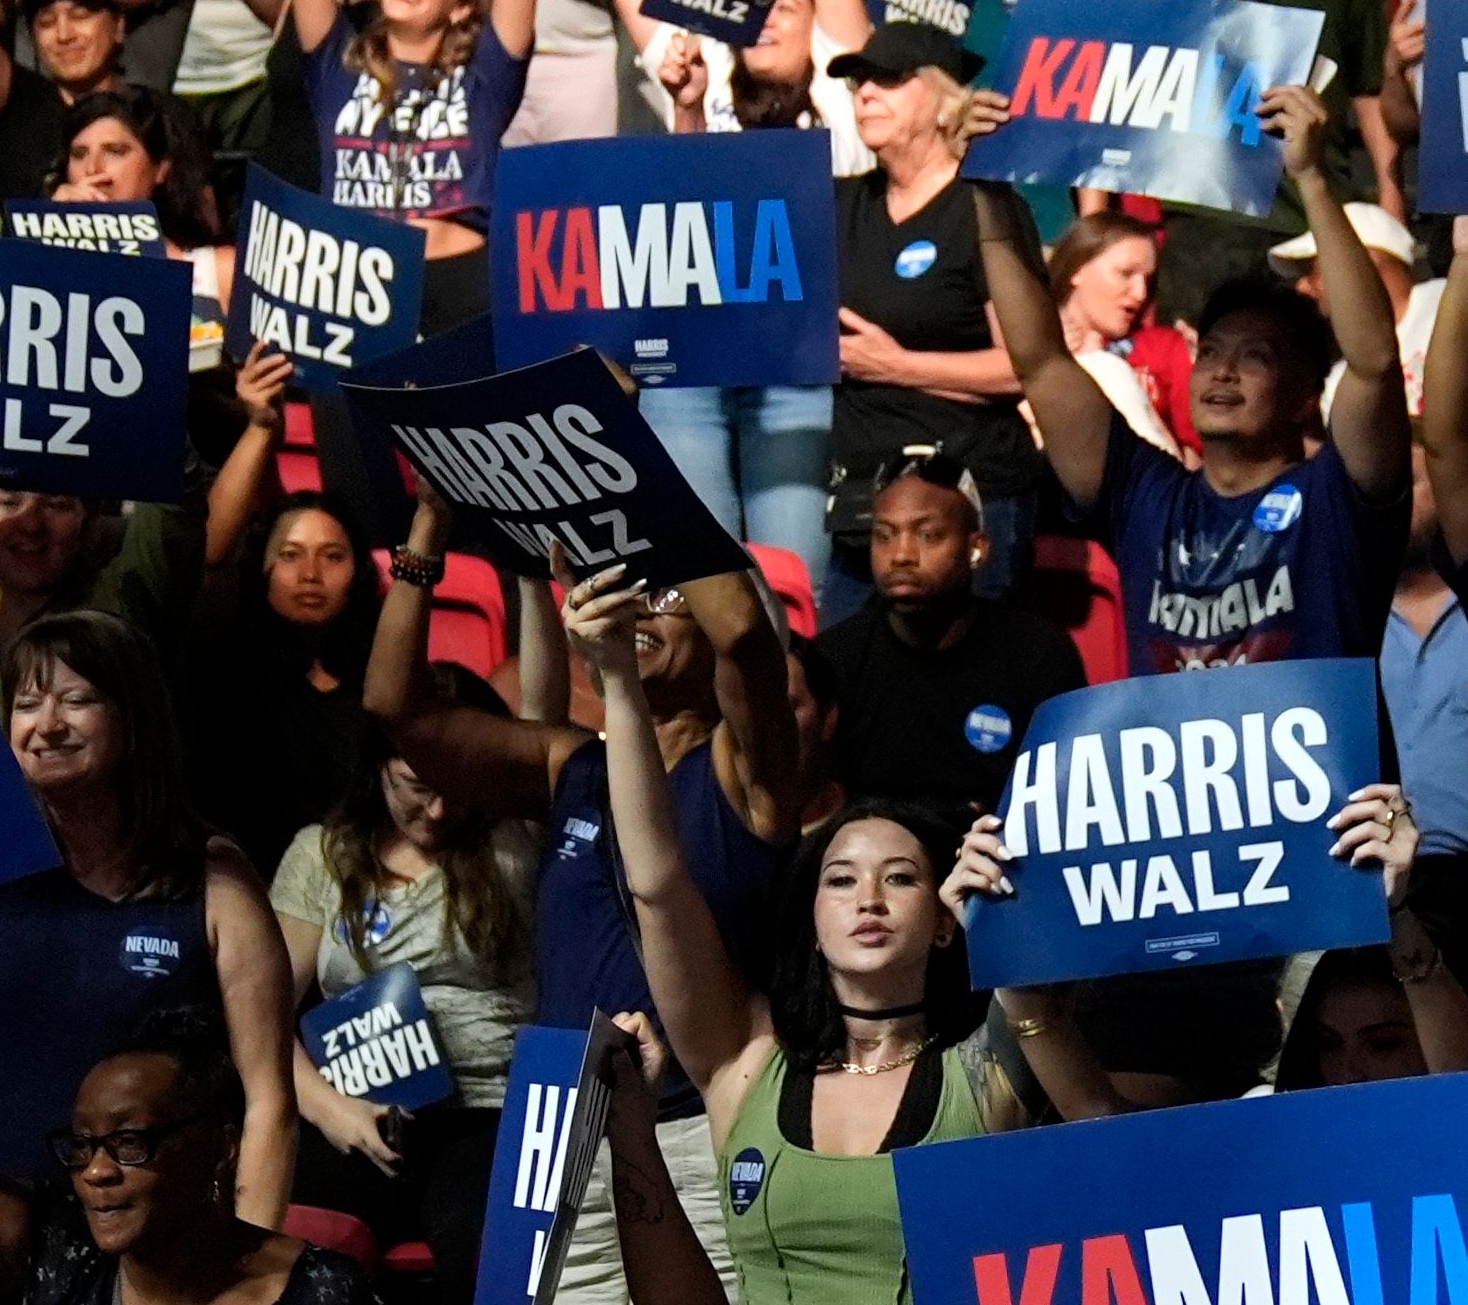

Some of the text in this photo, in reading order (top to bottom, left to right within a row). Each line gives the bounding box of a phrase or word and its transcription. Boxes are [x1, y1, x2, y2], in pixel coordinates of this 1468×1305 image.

[11, 209, 161, 242] HARRIS
[244, 198, 394, 327] HARRIS
[516, 198, 804, 314] KAMALA
[249, 301, 354, 368] WALZ
[392, 402, 639, 512] HARRIS
[1005, 705, 1334, 856] HARRIS
[1062, 840, 1291, 927] WALZ
[123, 935, 180, 959] NEVADA
[322, 1000, 404, 1054] WALZ
